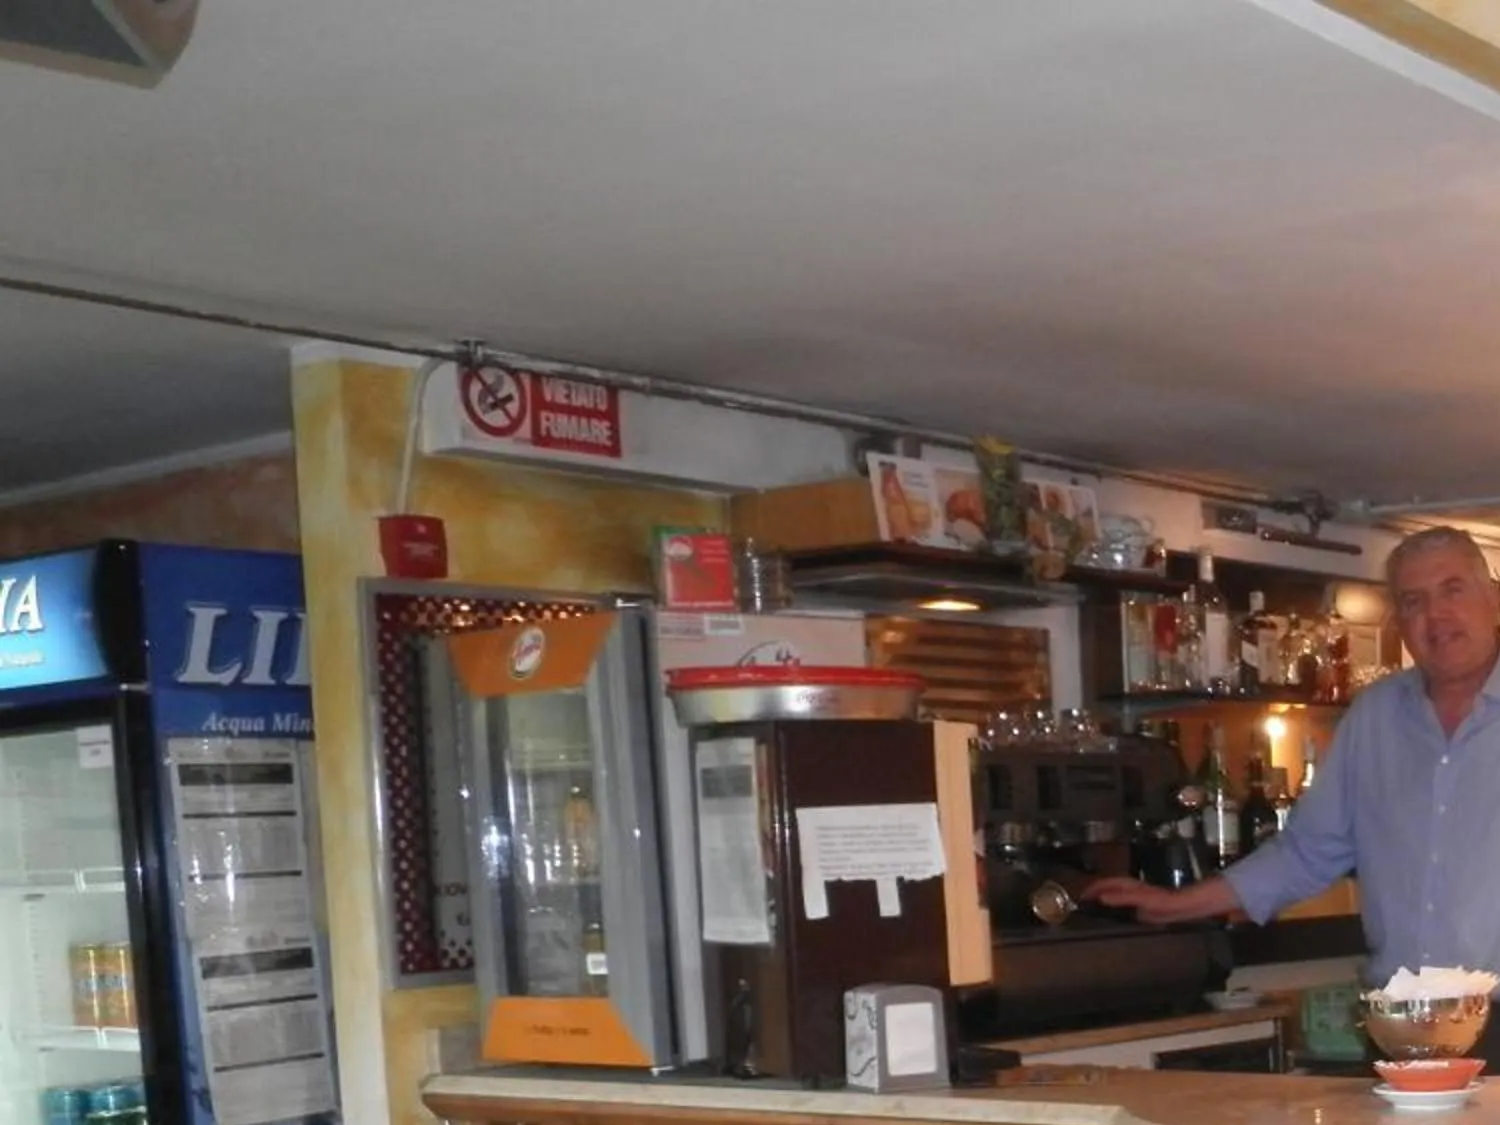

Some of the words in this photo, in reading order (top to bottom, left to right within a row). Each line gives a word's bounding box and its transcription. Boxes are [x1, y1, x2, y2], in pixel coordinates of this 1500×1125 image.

[542, 376, 608, 412] VIETATO
[539, 409, 613, 447] FUMARE
[201, 711, 266, 737] Acqua
